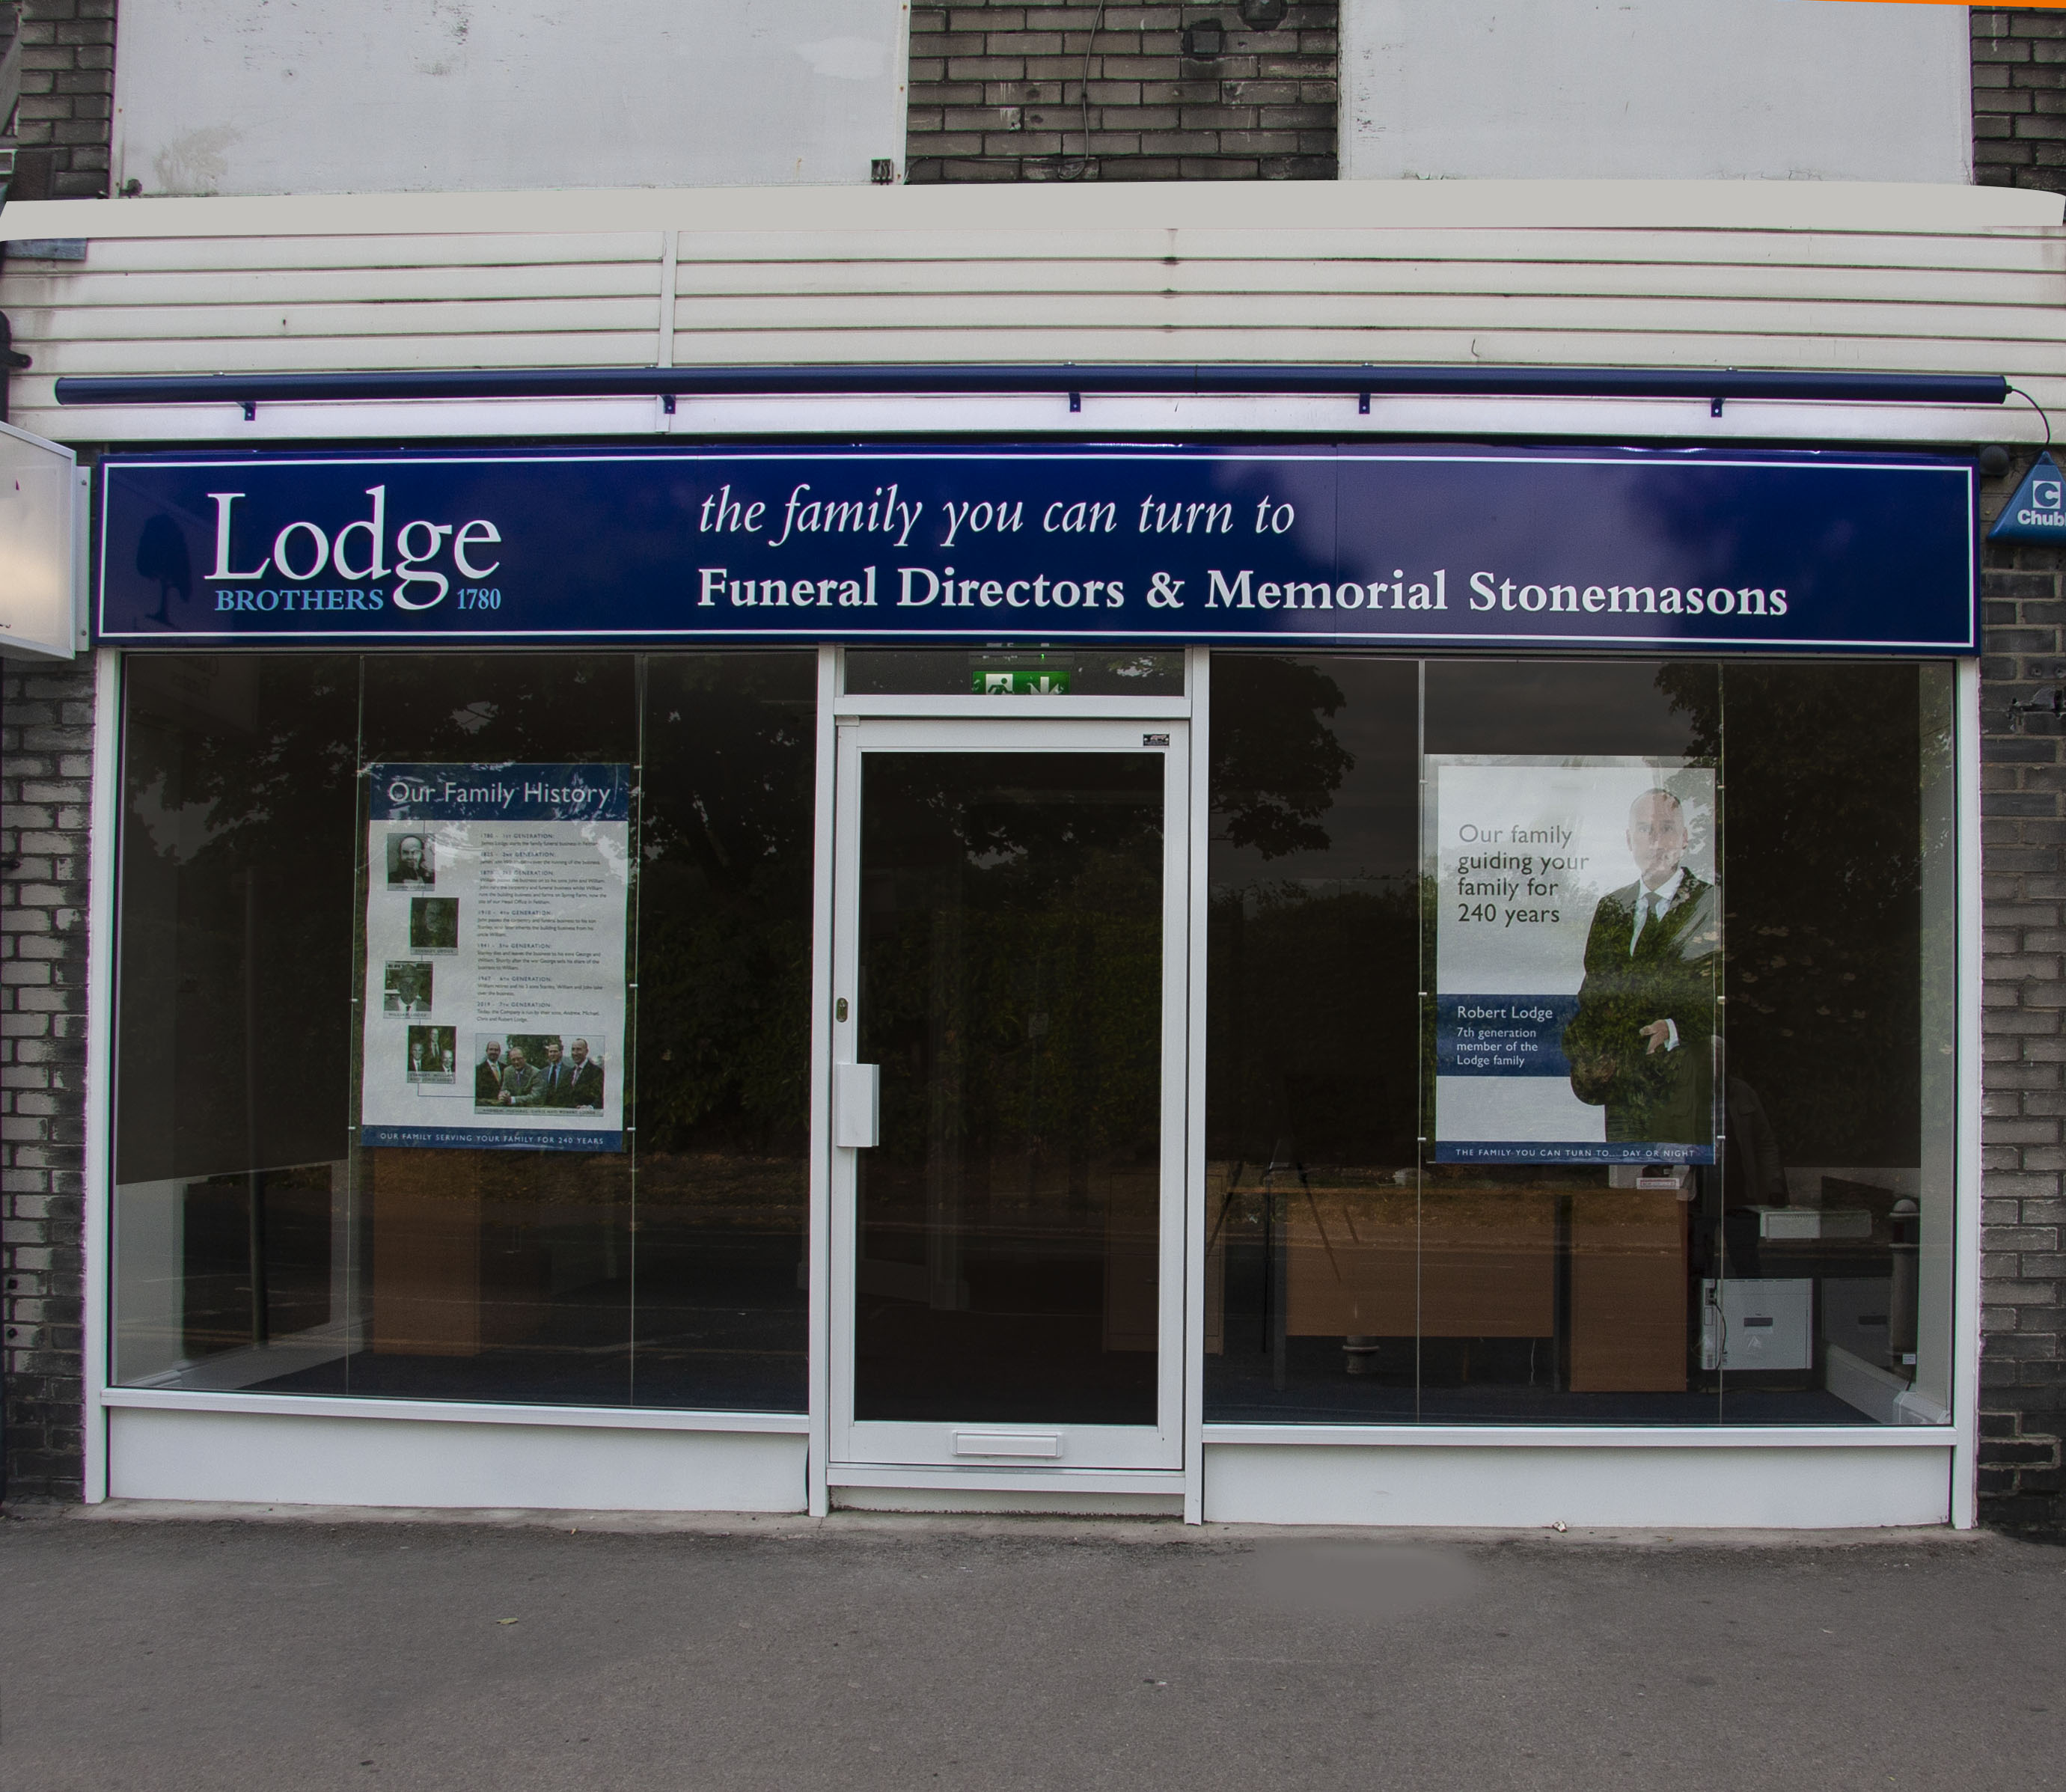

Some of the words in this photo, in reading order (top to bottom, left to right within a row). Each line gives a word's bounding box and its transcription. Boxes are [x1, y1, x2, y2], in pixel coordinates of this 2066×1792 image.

[700, 485, 765, 532] the
[768, 484, 922, 546] family
[940, 502, 1023, 546] you
[1044, 503, 1116, 532] can
[1140, 495, 1232, 533] turn
[1256, 496, 1294, 533] to
[2017, 510, 2066, 527] Chub
[205, 485, 501, 609] Lodge
[215, 590, 383, 611] BROTHERS
[458, 589, 501, 609] 1780
[698, 566, 878, 606] Funeral
[897, 567, 1124, 607] Directors
[1147, 572, 1185, 608] &
[1205, 569, 1447, 609] Memorial
[1470, 572, 1786, 614] Stonemasons
[388, 782, 435, 803] Our
[445, 783, 514, 808] Family
[525, 780, 610, 810] History
[1459, 825, 1503, 843] Our
[1512, 825, 1572, 848] family
[1458, 851, 1532, 875] guiding
[1541, 856, 1589, 875] your
[1458, 878, 1519, 901] family
[1527, 878, 1558, 896] for
[1459, 904, 1496, 922] 240
[1506, 910, 1559, 927] years
[1458, 1006, 1506, 1018] Robert
[1512, 1006, 1552, 1021] Lodge
[1457, 1027, 1475, 1038] 7th
[1478, 1027, 1537, 1041] generation
[1456, 1041, 1502, 1051] member
[1506, 1041, 1518, 1051] of
[1521, 1042, 1538, 1052] the
[1457, 1054, 1490, 1068] Lodge
[1493, 1054, 1525, 1068] family
[435, 1134, 472, 1142] SERVING
[503, 1135, 534, 1143] FAMILY
[1645, 1149, 1660, 1158] OR
[1663, 1149, 1696, 1158] NIGHT
